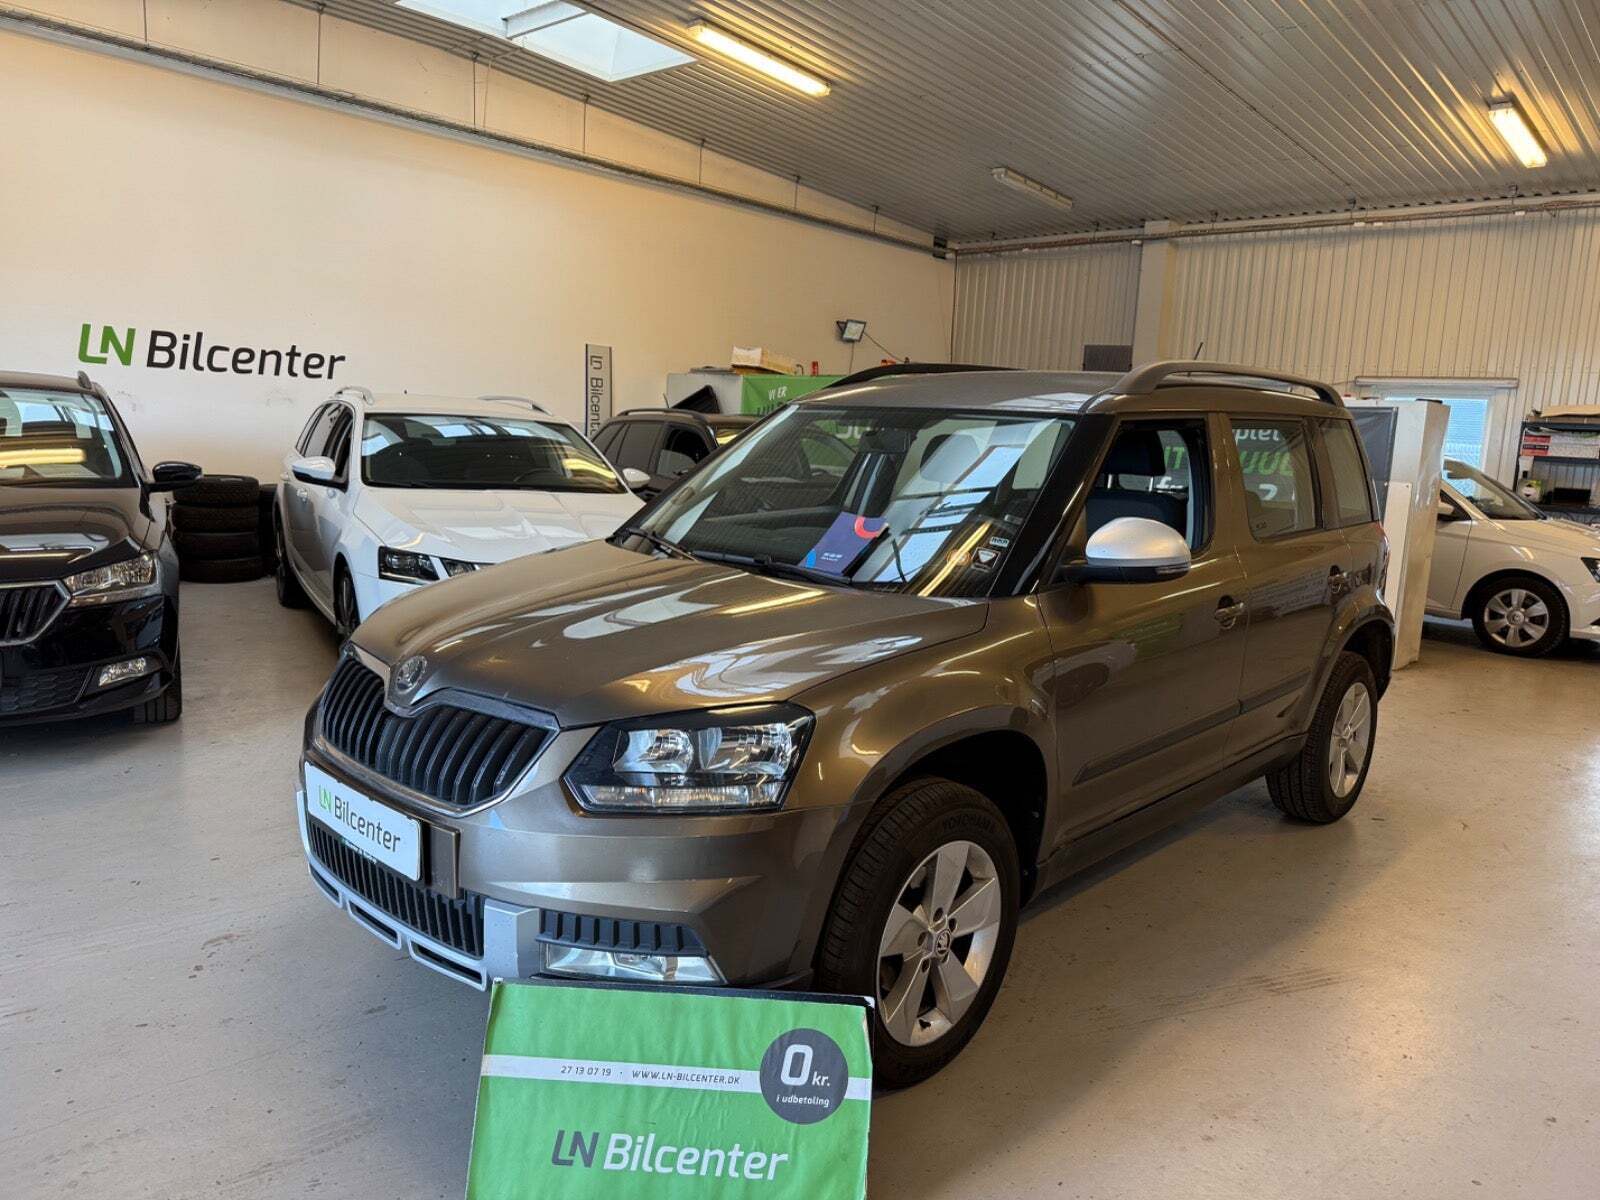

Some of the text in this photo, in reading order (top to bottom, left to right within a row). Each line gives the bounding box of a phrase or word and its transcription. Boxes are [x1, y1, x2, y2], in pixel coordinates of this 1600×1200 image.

[78, 323, 346, 380] LN Bilcenter
[334, 795, 401, 853] Bilcenter
[561, 1065, 741, 1085] 27 13 07 19 WWW.LN-BILCENTER.DK
[780, 1043, 831, 1087] 0 kr.
[781, 1095, 830, 1108] udbetaling
[551, 1129, 789, 1181] LN Bilcenter
